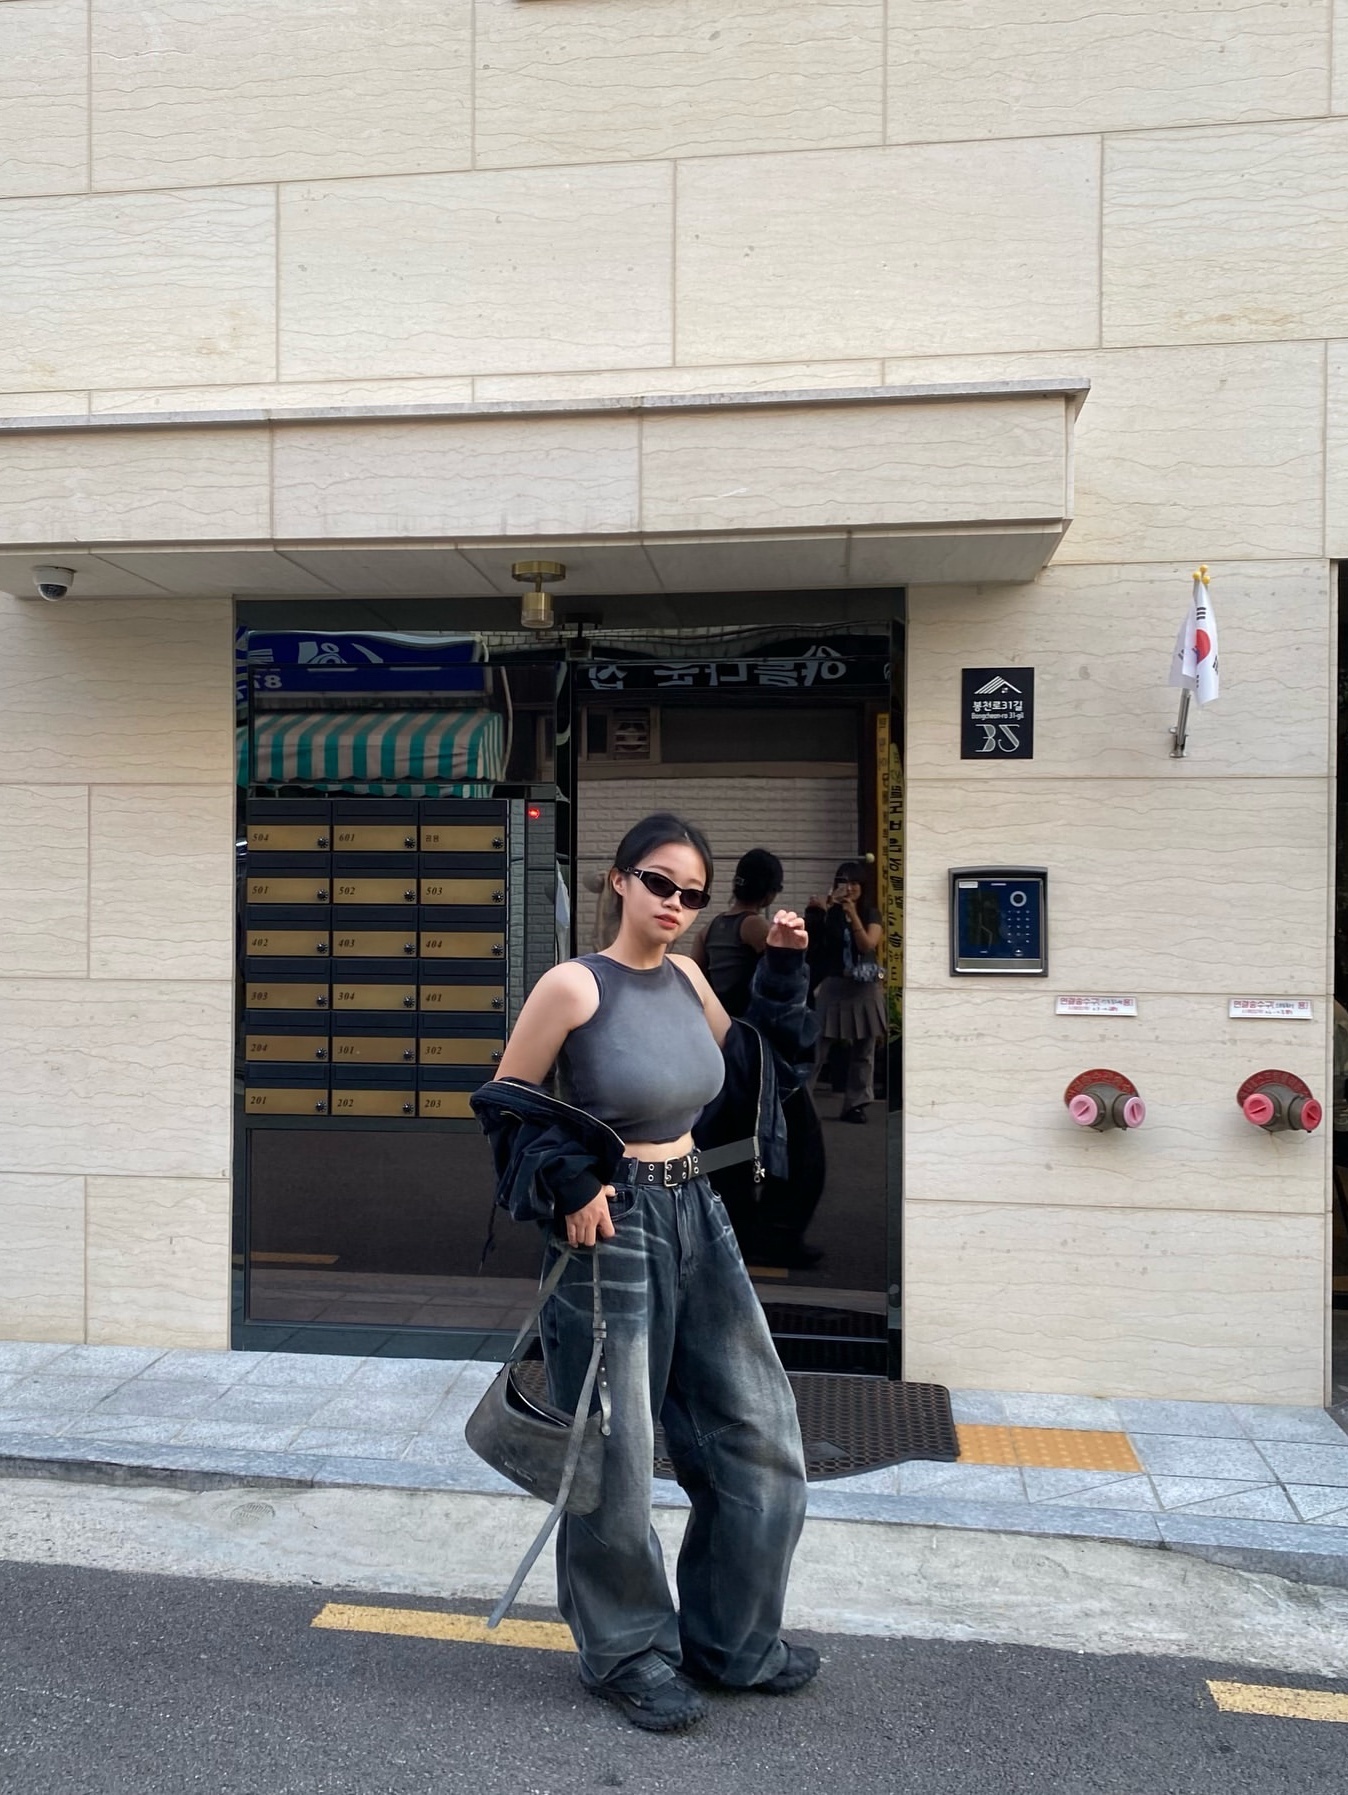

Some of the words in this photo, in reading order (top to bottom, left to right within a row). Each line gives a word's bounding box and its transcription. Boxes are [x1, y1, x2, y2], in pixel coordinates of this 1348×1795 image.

[972, 700, 1023, 712] 봉천로31길
[252, 833, 269, 842] 504
[338, 833, 355, 842] 601
[251, 885, 269, 895] 501
[338, 886, 356, 895] 502
[425, 886, 443, 896] 503
[251, 938, 269, 947] 402
[338, 939, 355, 948] 403
[425, 940, 443, 949] 404
[337, 991, 355, 1001] 304
[425, 993, 442, 1002] 401
[425, 1046, 443, 1055] 302
[250, 1095, 267, 1105] 201
[337, 1098, 354, 1108] 202
[424, 1099, 442, 1108] 203
